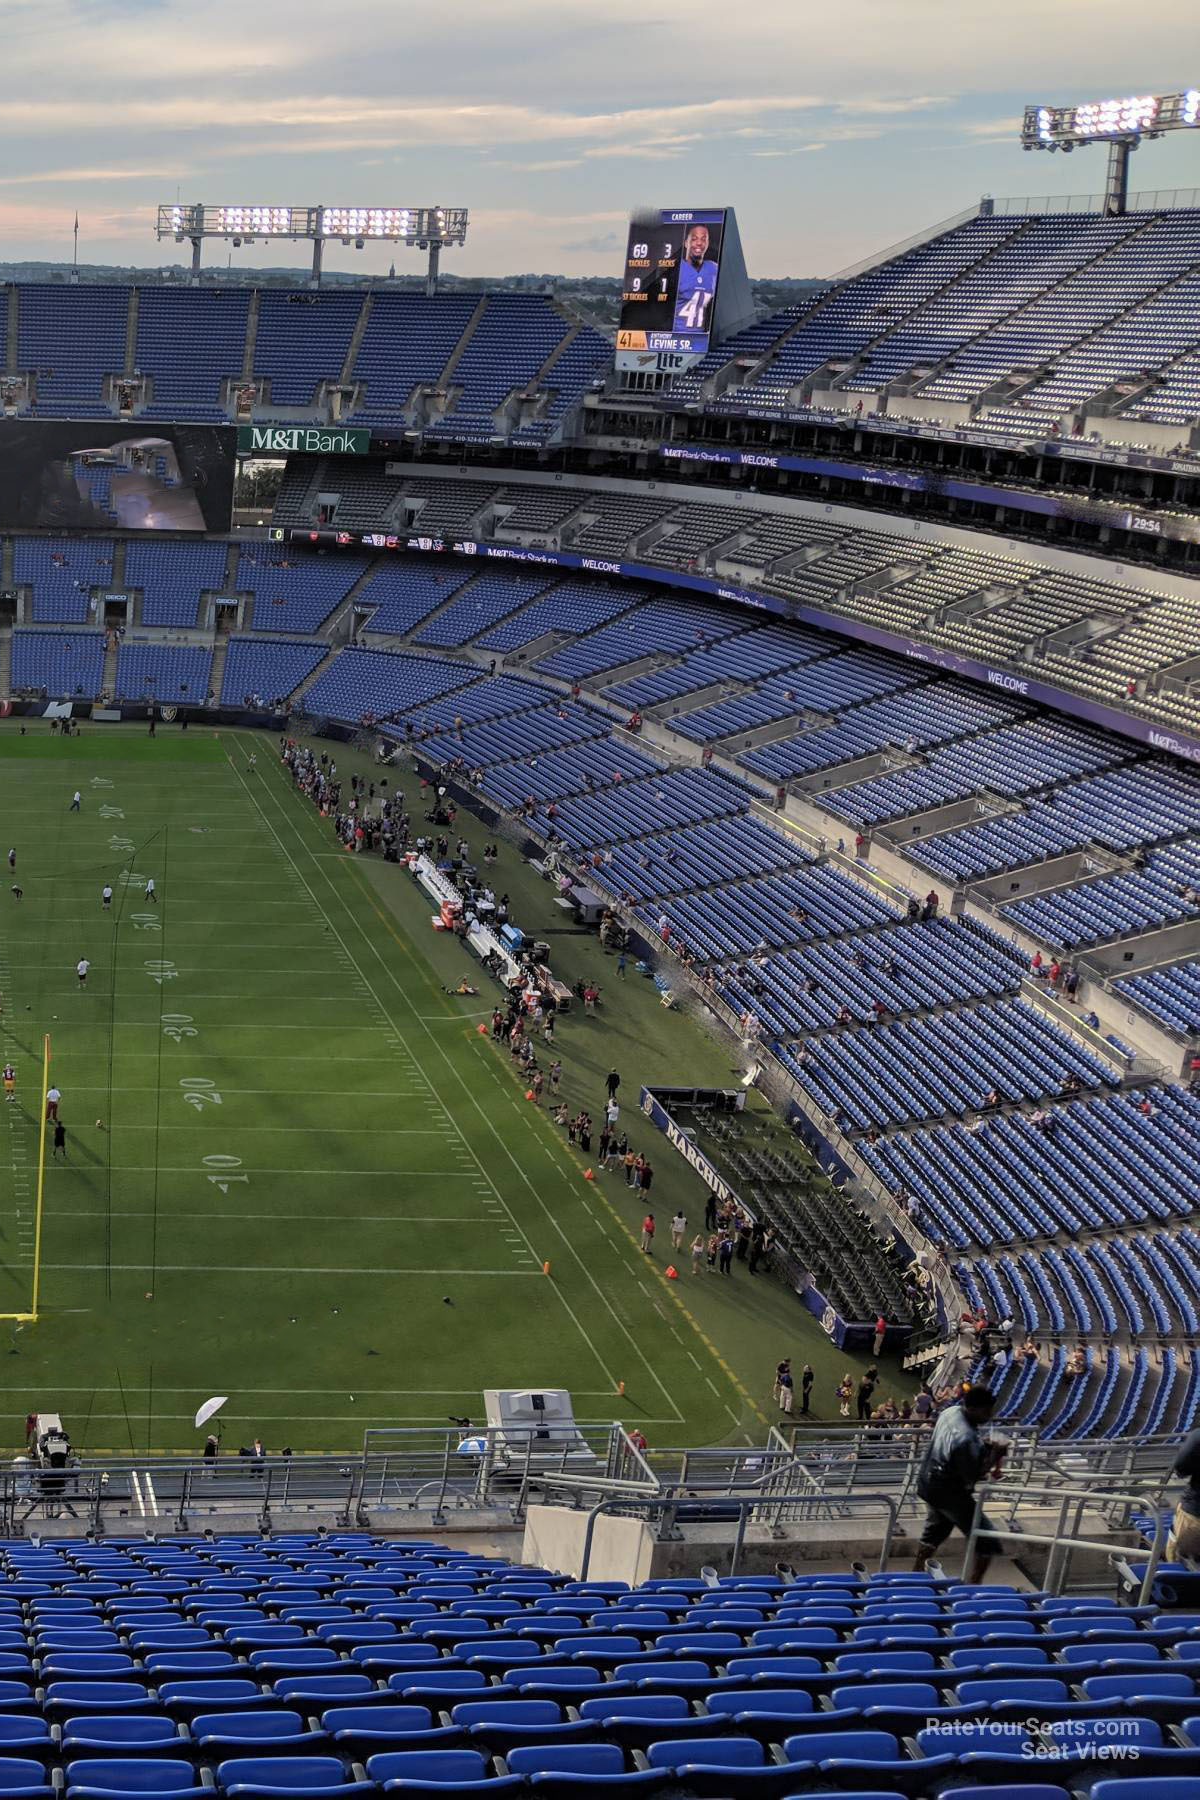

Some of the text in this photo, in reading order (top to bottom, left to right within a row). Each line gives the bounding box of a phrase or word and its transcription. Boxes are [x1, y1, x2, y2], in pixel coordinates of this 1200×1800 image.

[633, 244, 672, 258] 69 3
[632, 278, 667, 292] 9 1
[620, 332, 632, 347] 41
[650, 339, 677, 349] LEVINE
[679, 340, 692, 350] SR.
[656, 352, 683, 371] Lite
[251, 428, 357, 453] M&T Bank
[741, 454, 777, 467] WELCOME
[1133, 518, 1160, 532] 29:54
[276, 530, 282, 539] 0
[488, 548, 509, 558] M&T
[582, 558, 620, 573] WELCOME
[987, 670, 1028, 695] WELCOME
[130, 912, 162, 931] 50
[144, 960, 180, 982] 40
[160, 1014, 199, 1038] 30
[179, 1078, 223, 1106] 20
[202, 1154, 250, 1185] 10
[666, 1122, 738, 1211] MARCHIN
